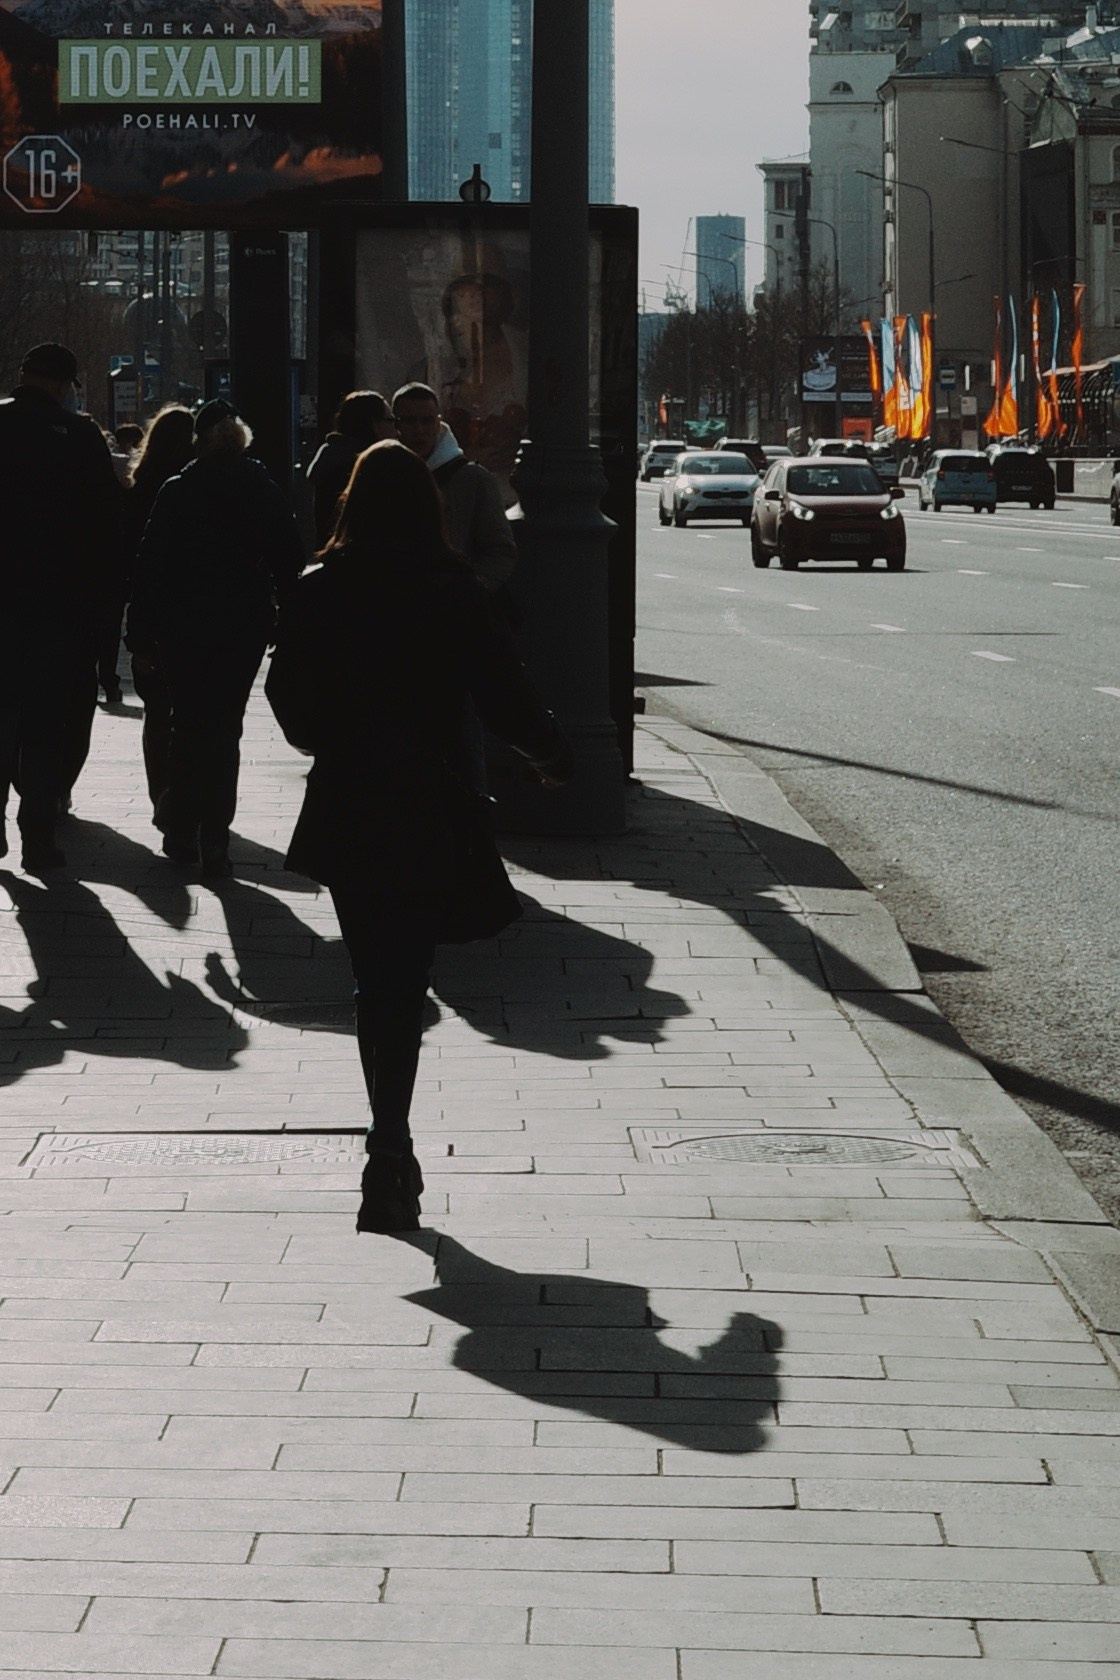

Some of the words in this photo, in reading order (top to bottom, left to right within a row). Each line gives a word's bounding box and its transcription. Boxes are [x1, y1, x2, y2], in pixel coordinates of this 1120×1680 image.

[104, 22, 278, 35] ТЕЛЕКАНАЛ
[69, 45, 310, 98] ПОЕХАЛИ!
[123, 113, 258, 129] POEHALI.TV
[25, 149, 79, 199] 16+
